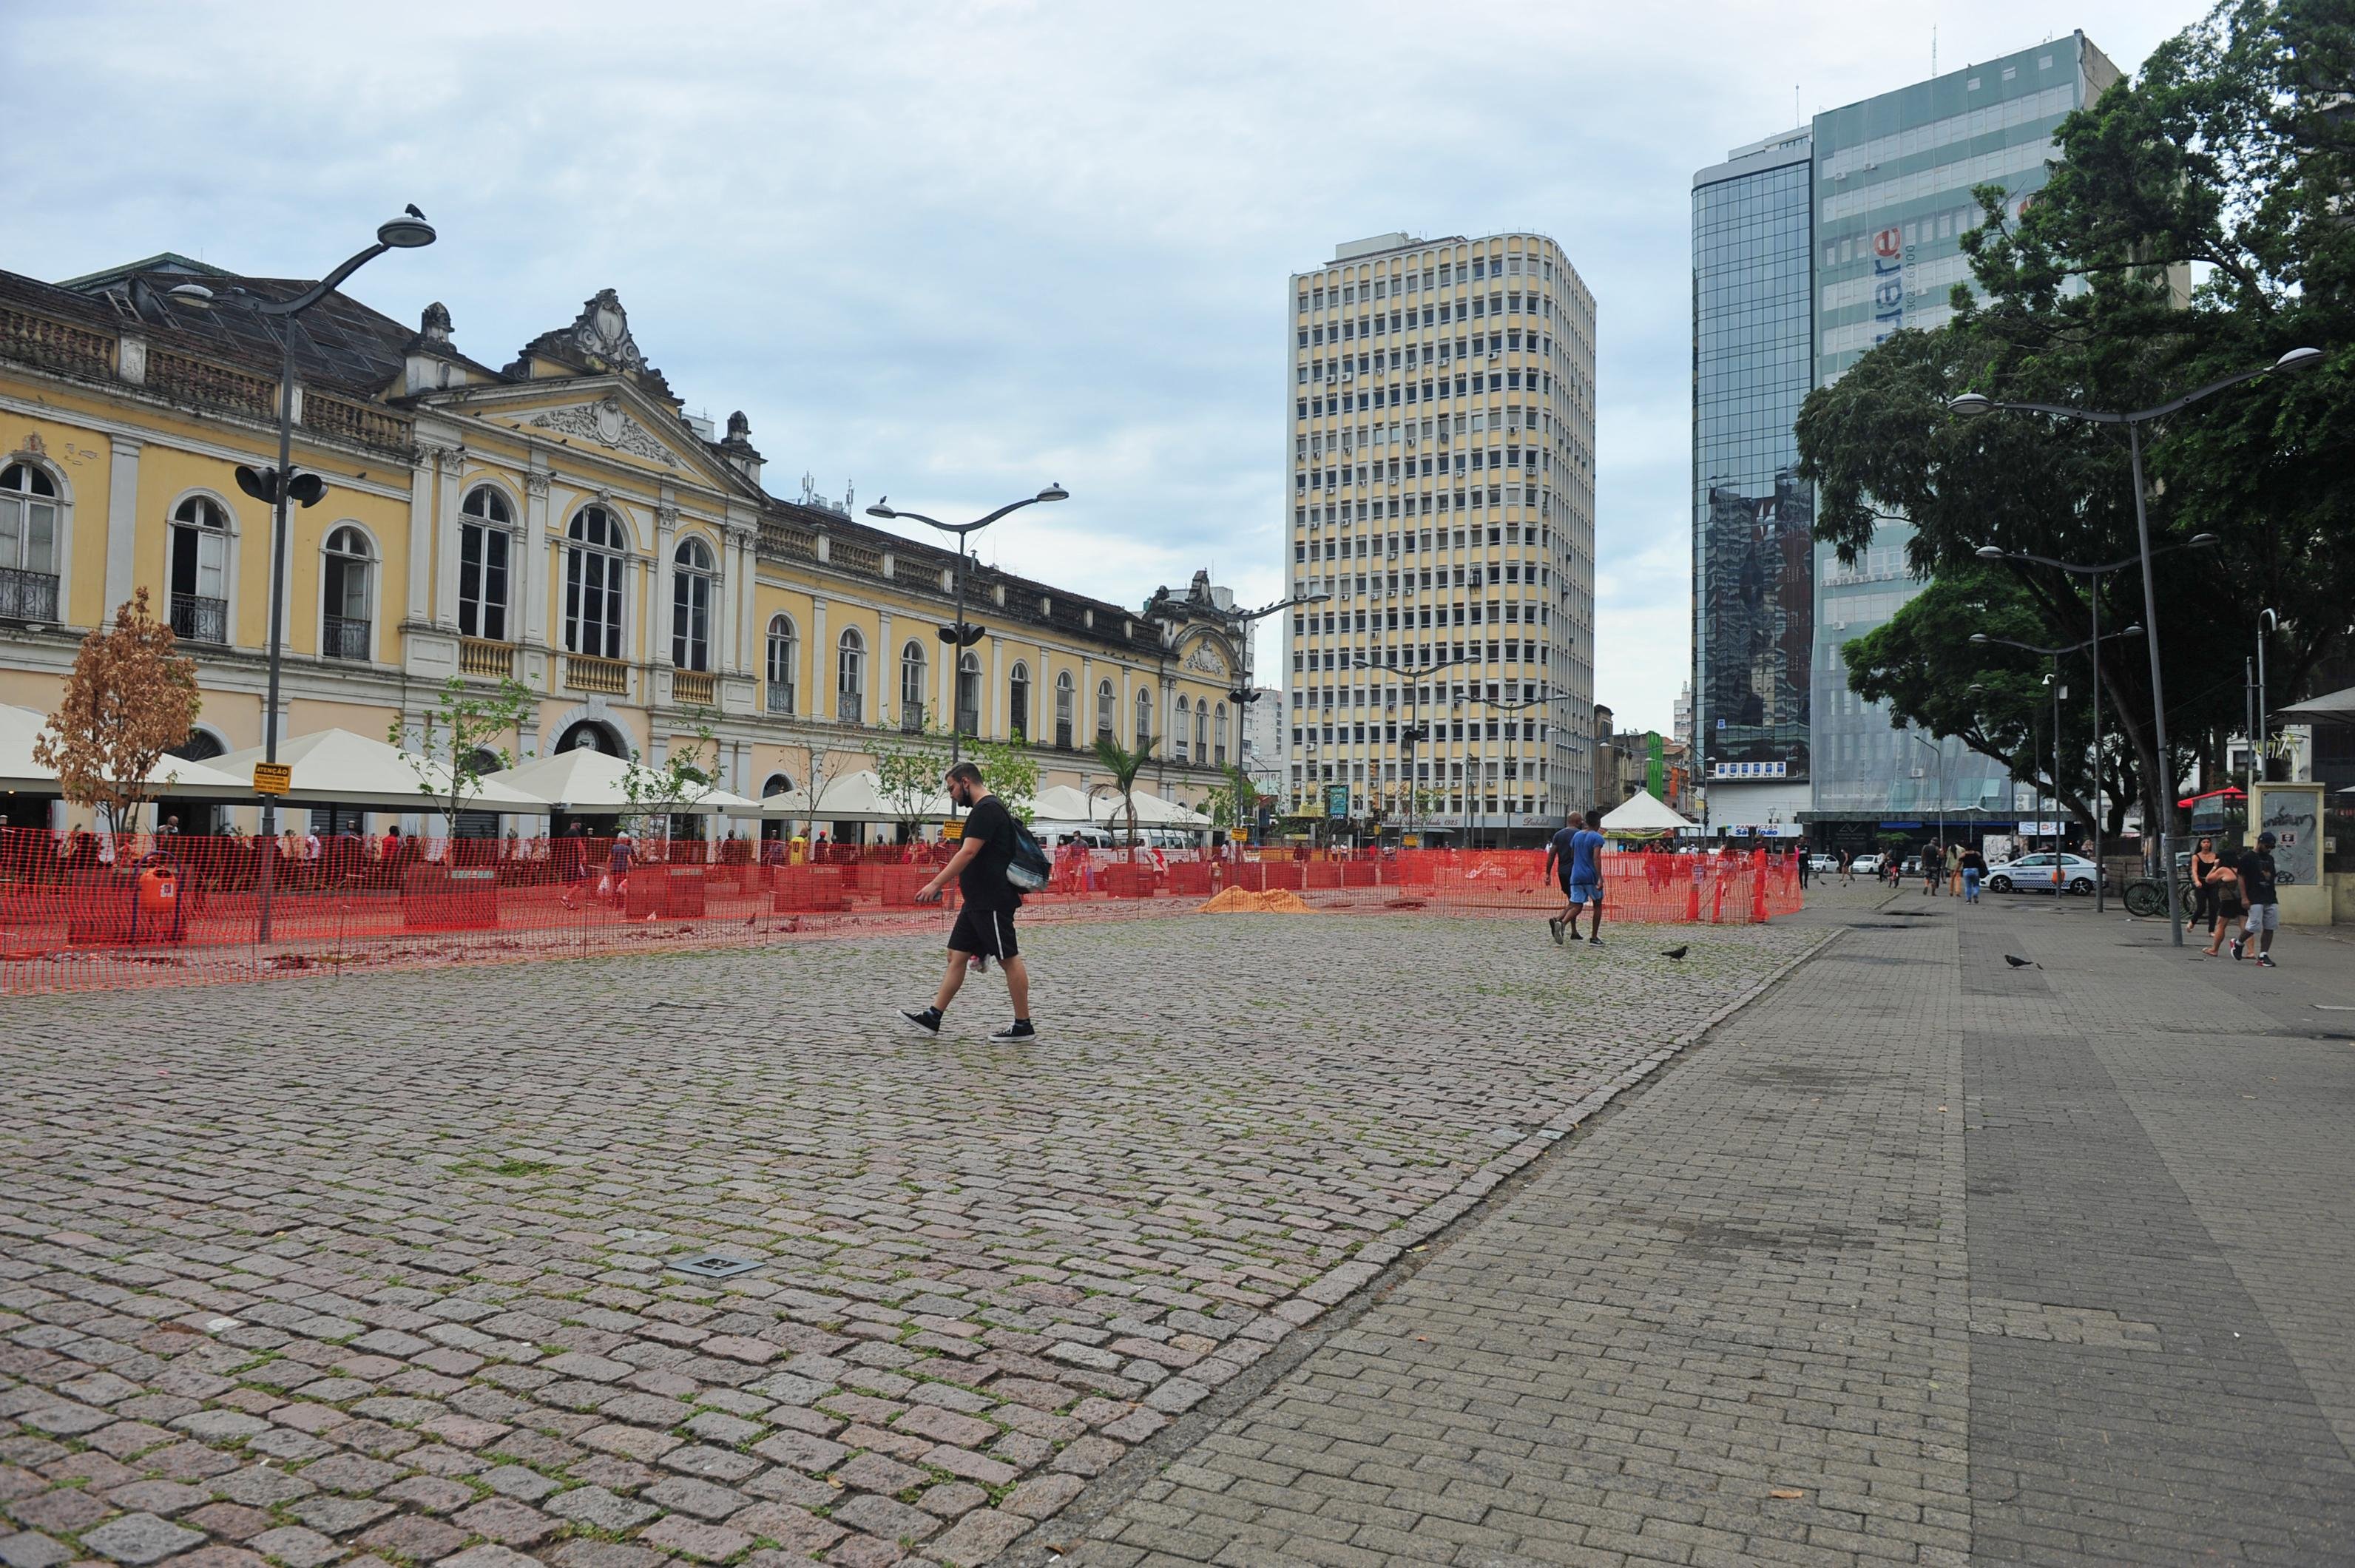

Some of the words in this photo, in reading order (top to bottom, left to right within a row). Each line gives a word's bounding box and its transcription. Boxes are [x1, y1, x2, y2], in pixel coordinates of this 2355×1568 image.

[1873, 228, 1902, 343] uar.e
[257, 766, 288, 775] ATENÇÃO
[1444, 818, 1459, 826] 1925
[792, 841, 800, 853] 10
